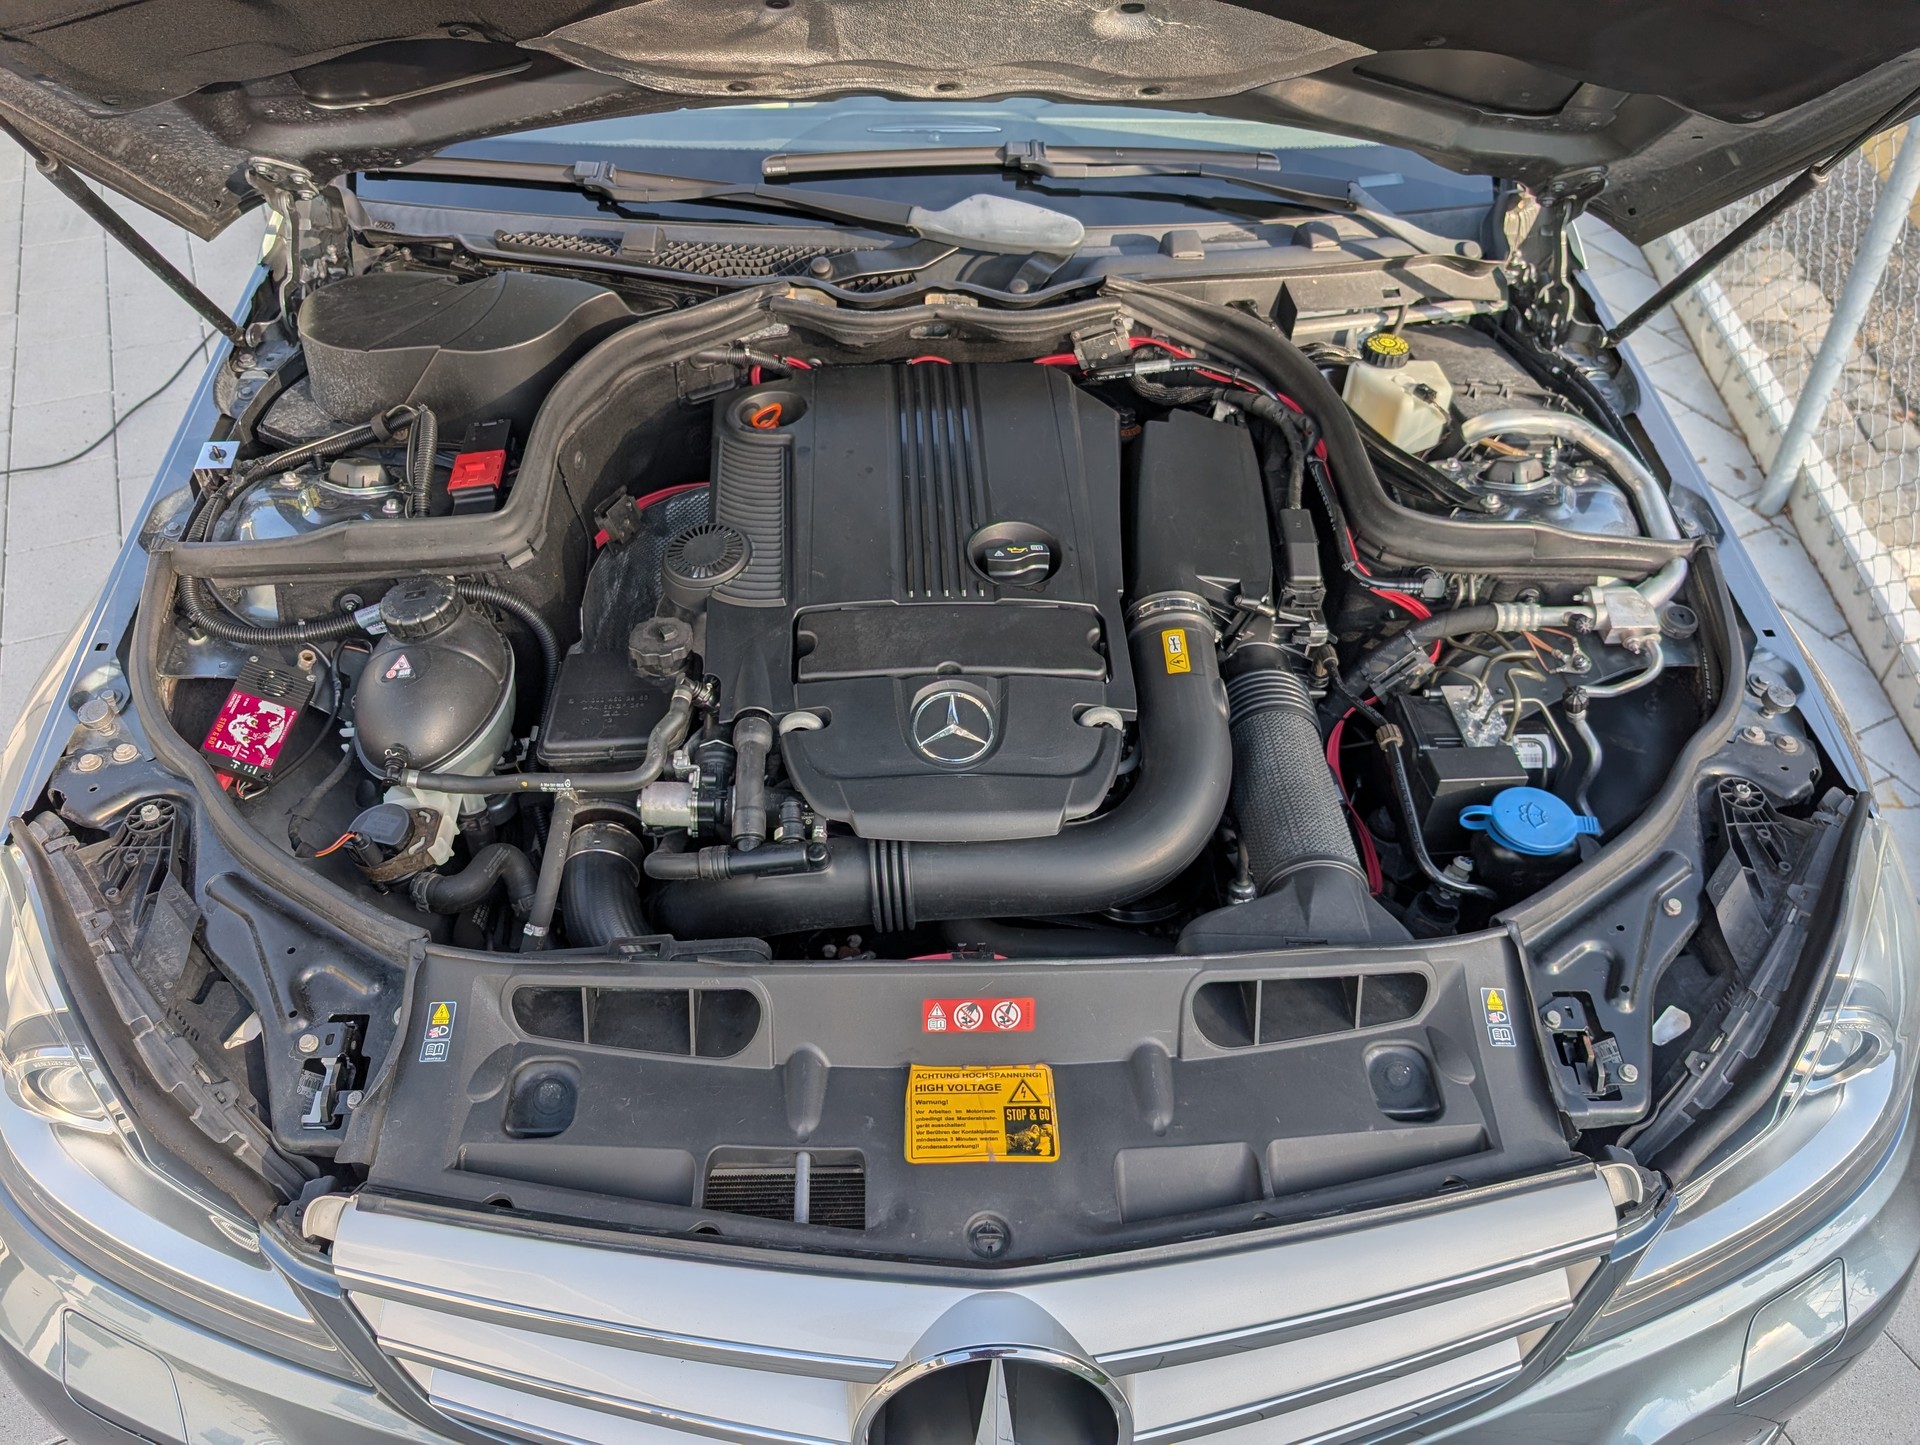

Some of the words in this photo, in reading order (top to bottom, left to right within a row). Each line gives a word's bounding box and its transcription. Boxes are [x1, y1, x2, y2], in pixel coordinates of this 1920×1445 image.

[215, 717, 228, 732] STOP
[915, 1084, 944, 1092] HIGH
[947, 1083, 1002, 1092] VOLTAGE
[1006, 1108, 1027, 1121] STOP
[1029, 1108, 1037, 1121] &
[1039, 1108, 1050, 1121] GO
